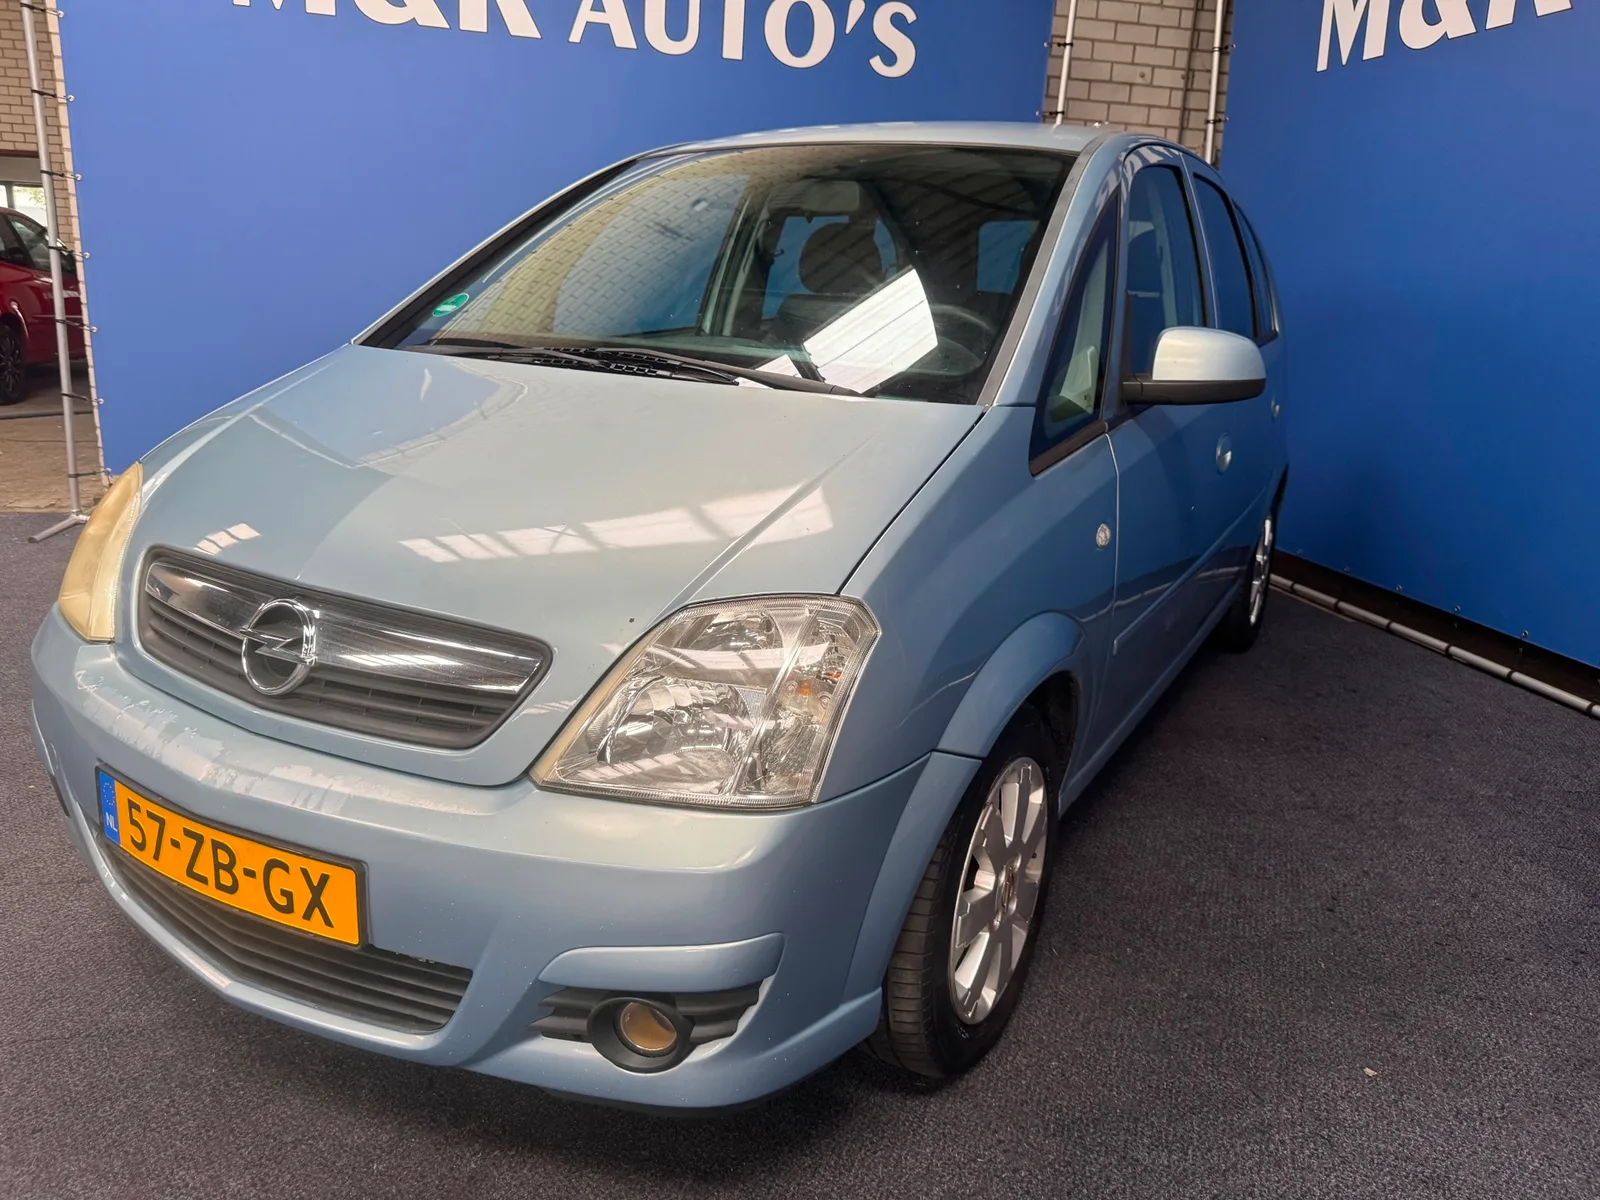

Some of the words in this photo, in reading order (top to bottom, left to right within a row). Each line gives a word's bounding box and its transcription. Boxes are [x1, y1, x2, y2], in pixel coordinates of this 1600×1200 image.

[568, 0, 917, 78] AUTO'S
[1316, 0, 1573, 73] M&
[105, 812, 118, 832] NL
[127, 798, 334, 928] 57-ZB-GX
